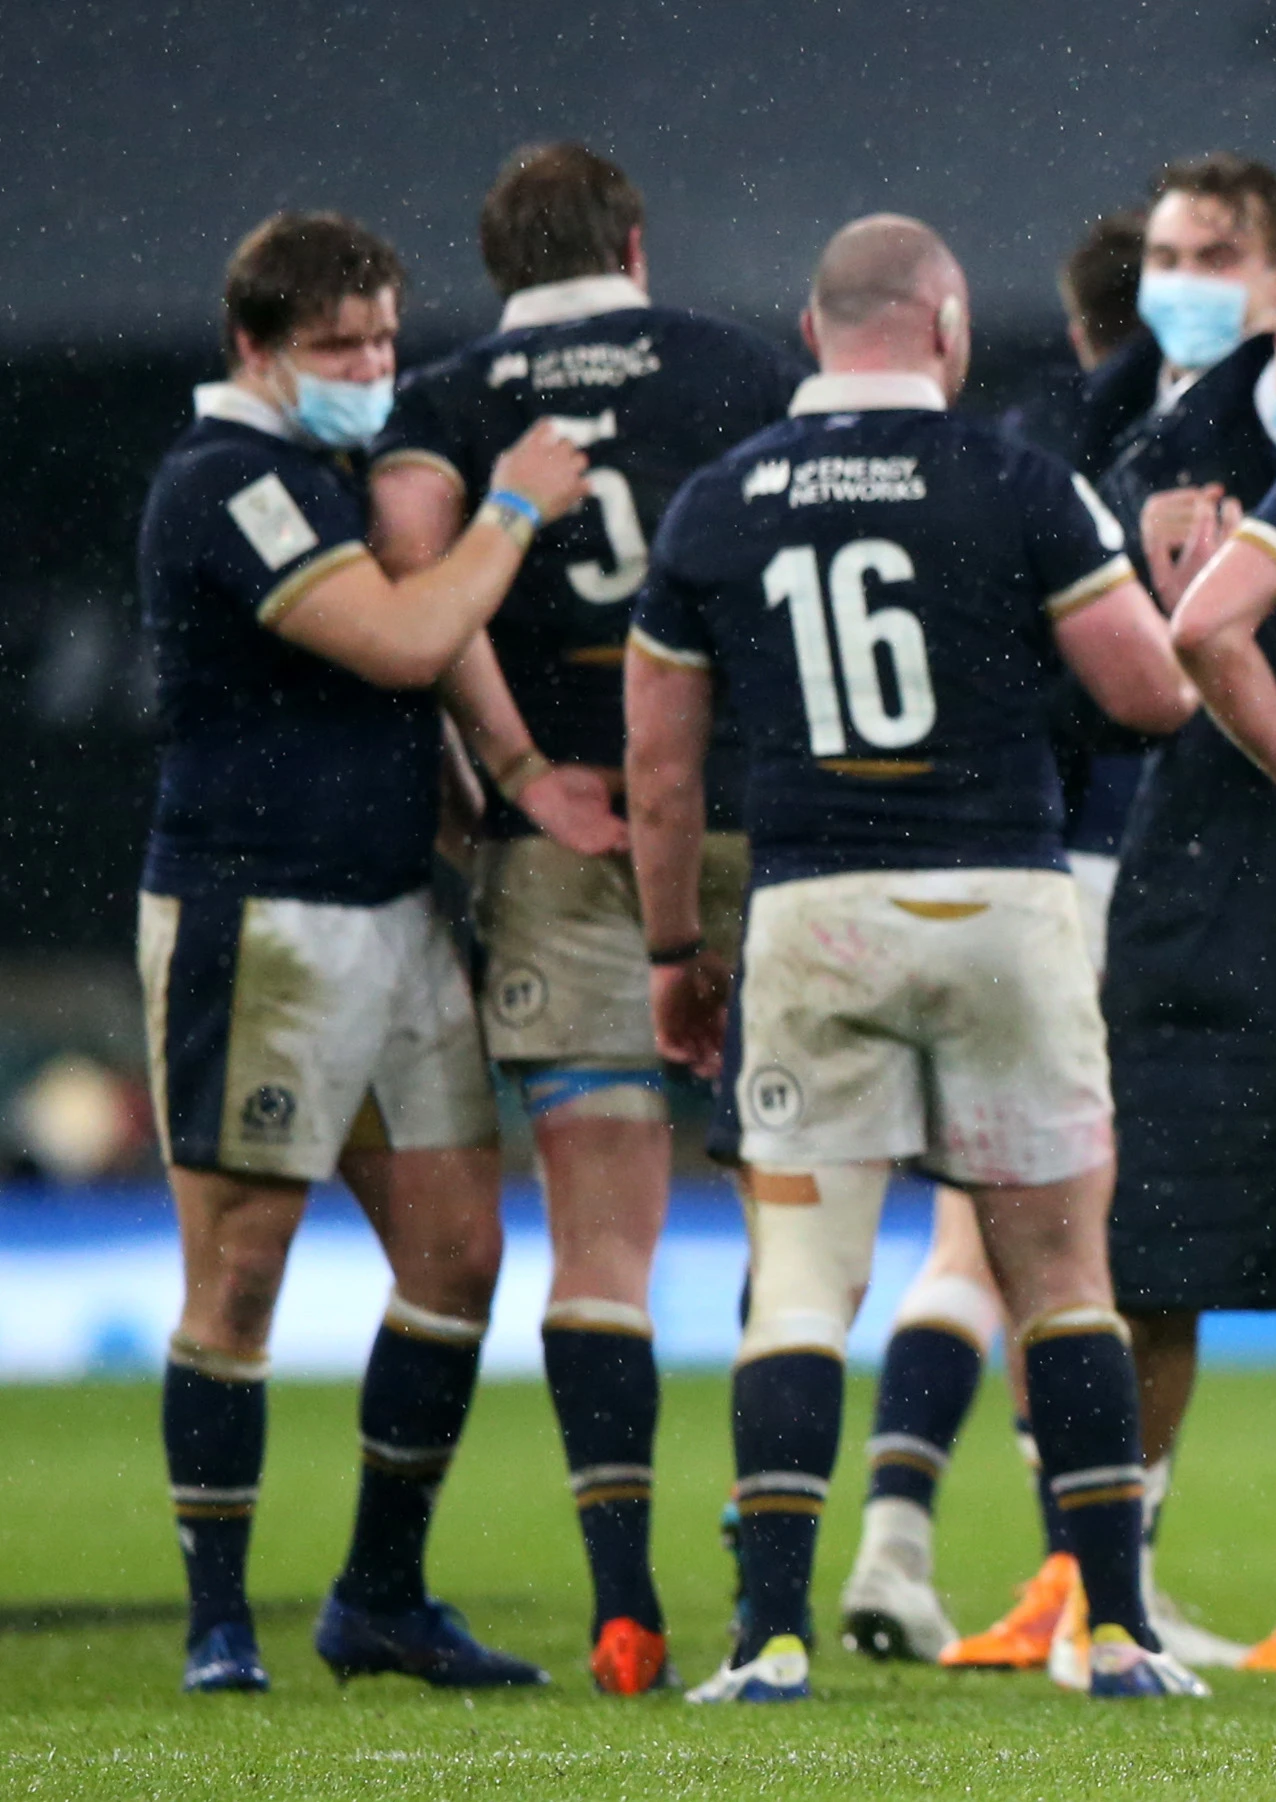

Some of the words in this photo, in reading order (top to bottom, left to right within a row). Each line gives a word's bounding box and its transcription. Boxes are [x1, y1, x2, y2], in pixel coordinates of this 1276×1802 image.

[550, 408, 650, 605] 5
[789, 474, 928, 509] NETWORKS
[760, 537, 936, 757] 16
